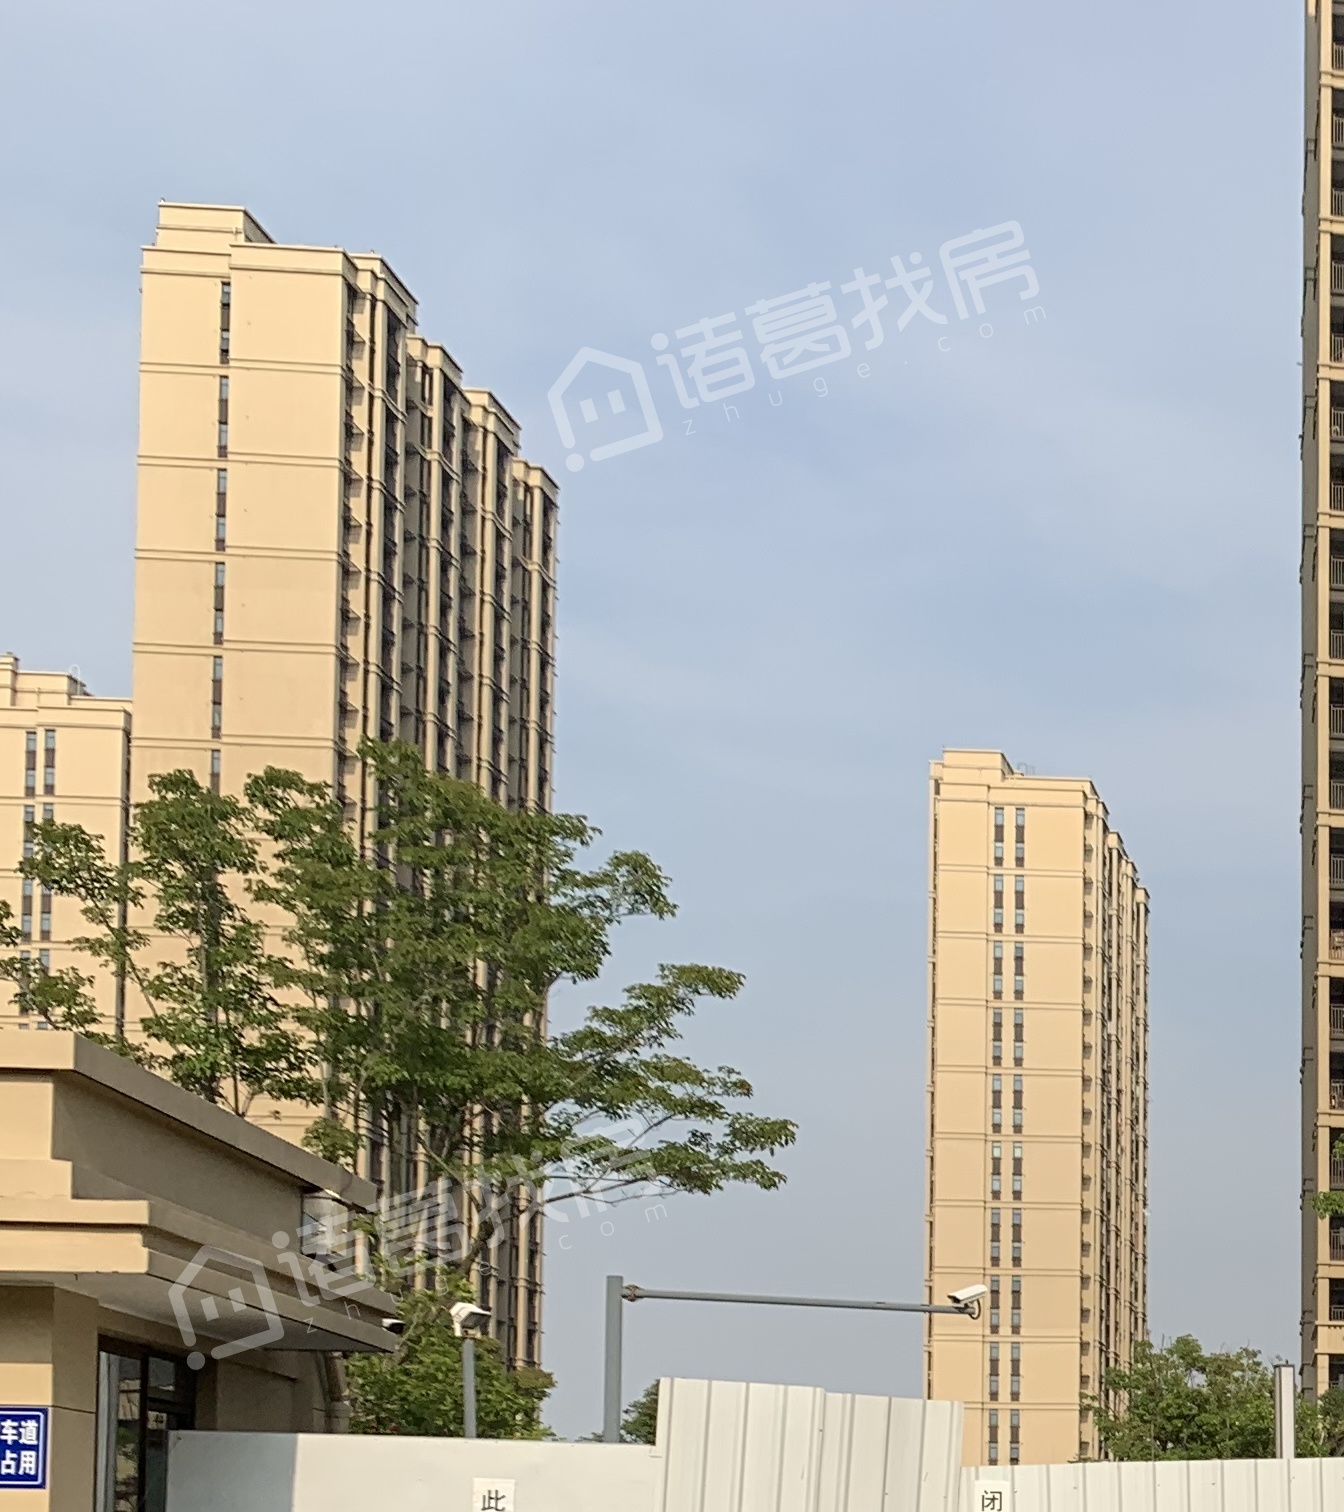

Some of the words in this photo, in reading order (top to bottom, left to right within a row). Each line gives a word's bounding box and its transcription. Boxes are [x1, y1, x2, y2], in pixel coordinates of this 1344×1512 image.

[0, 1419, 39, 1446] 车道
[0, 1449, 37, 1476] 占用
[481, 1489, 506, 1512] 此
[981, 1490, 1003, 1512] 闭
